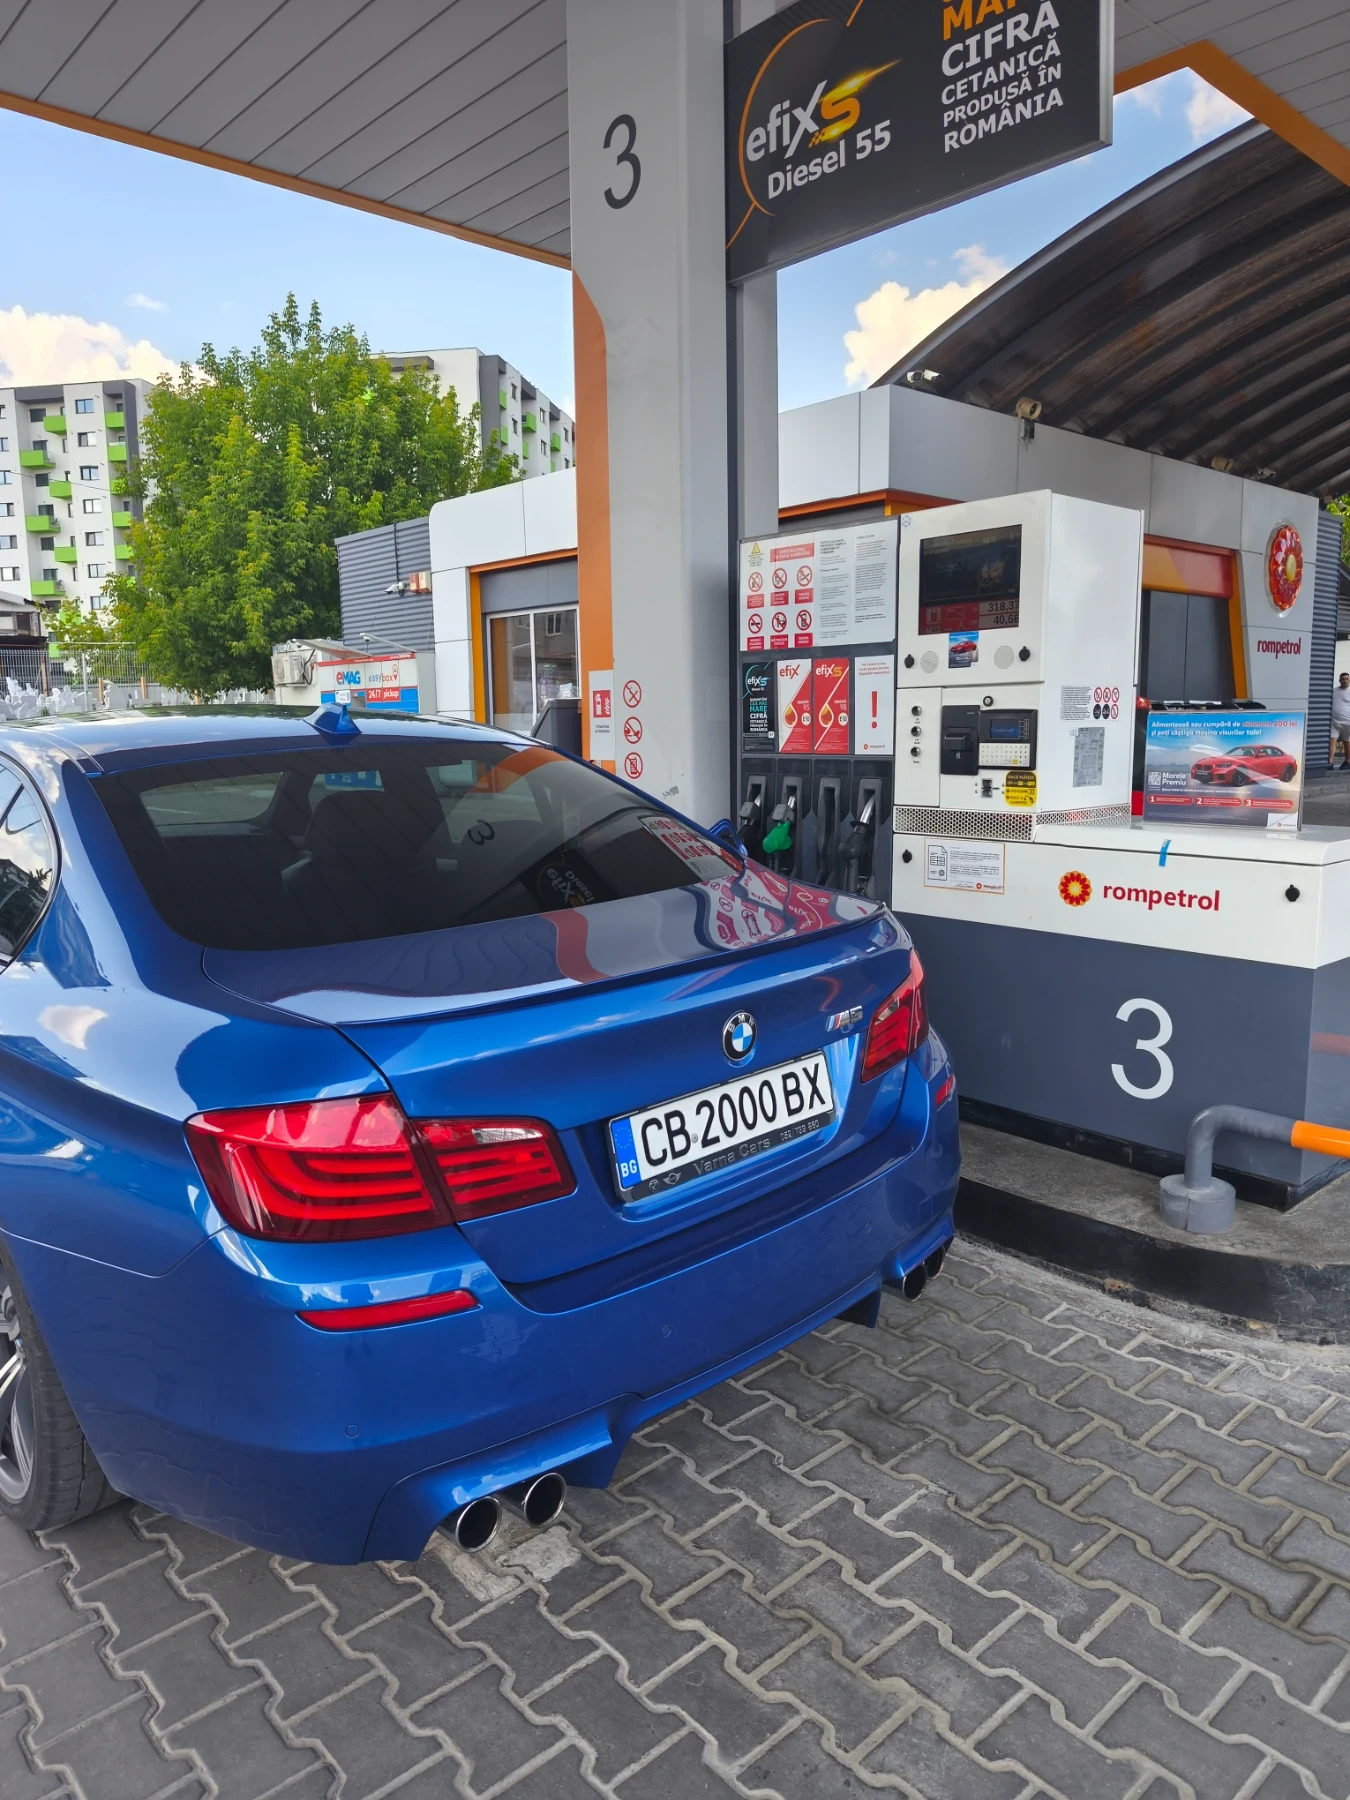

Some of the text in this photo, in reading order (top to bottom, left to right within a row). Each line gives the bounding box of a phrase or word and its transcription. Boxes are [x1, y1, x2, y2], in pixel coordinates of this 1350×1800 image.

[943, 0, 1016, 41] MA
[941, 31, 1061, 105] CETANICĂ
[943, 62, 1062, 128] PRODUSĂ ÎN
[944, 87, 1064, 154] ROMÂNIA
[603, 113, 642, 210] 3
[767, 119, 891, 200] Diesel 55
[1257, 637, 1302, 659] rompetrol
[336, 670, 361, 685] eMAG
[368, 688, 399, 699] 24/7 pickup
[1245, 799, 1251, 807] 3
[1102, 885, 1220, 912] rompetrol
[1111, 997, 1175, 1100] 3
[641, 1063, 827, 1167] CB 2000 BX
[620, 1159, 638, 1178] BG
[693, 1138, 771, 1175] Varna Cars
